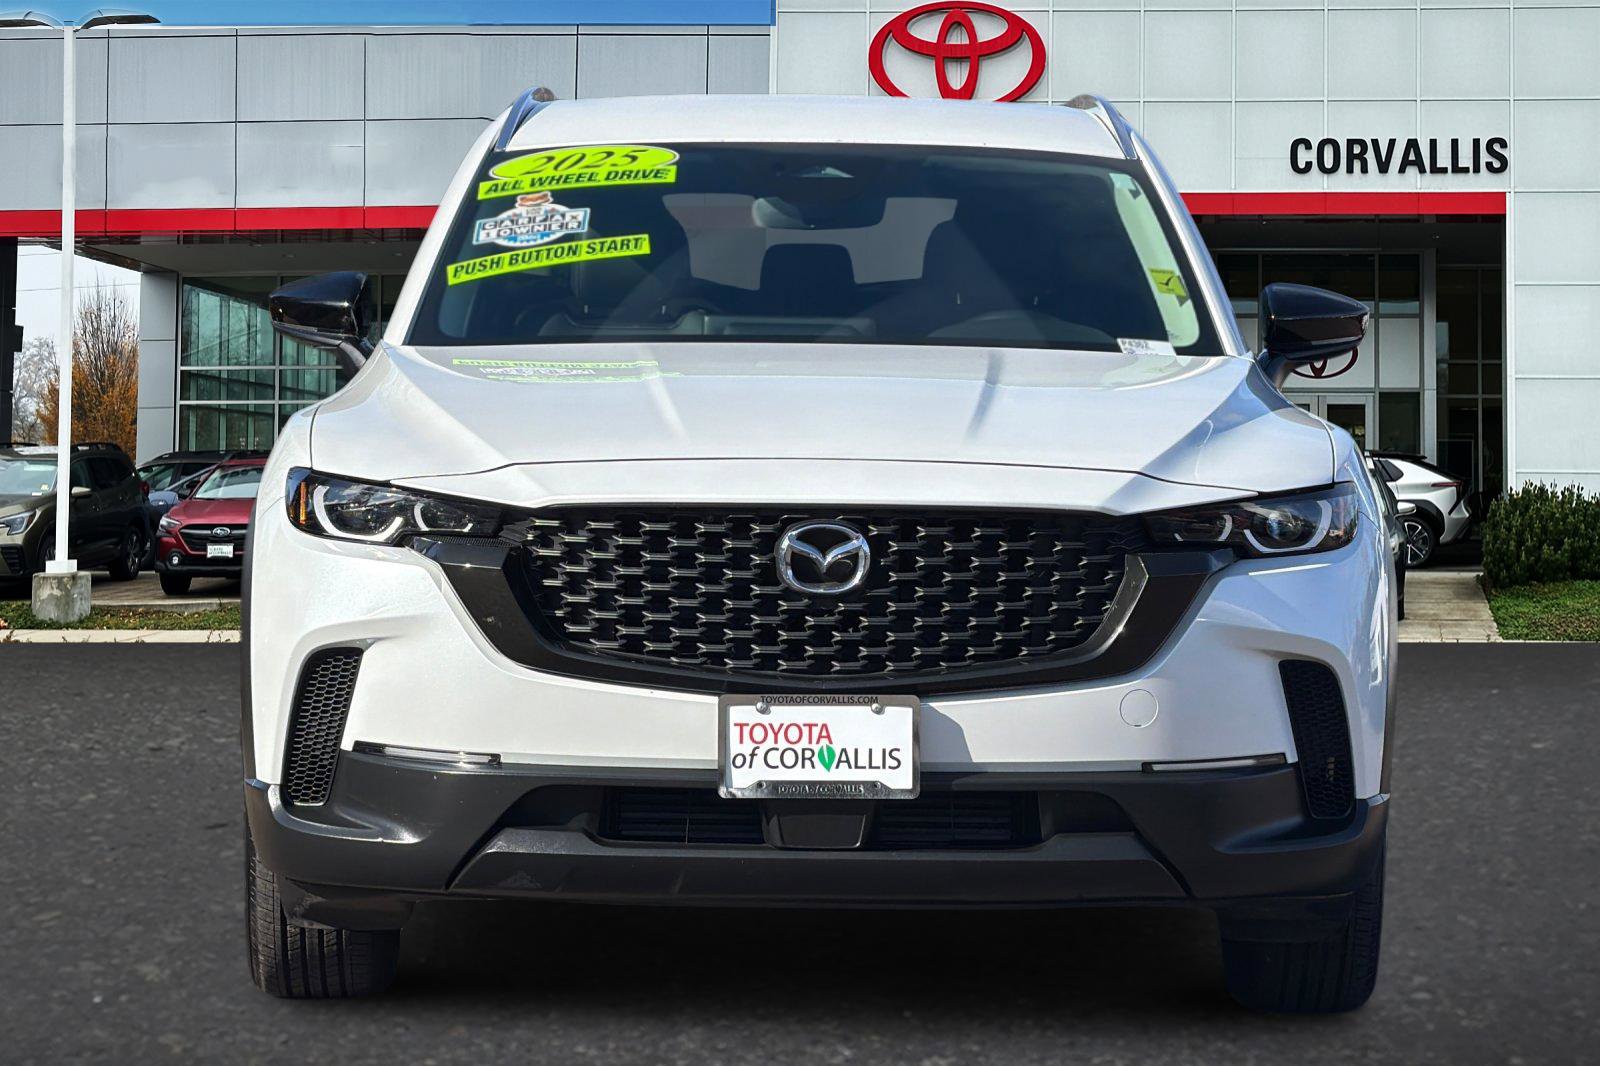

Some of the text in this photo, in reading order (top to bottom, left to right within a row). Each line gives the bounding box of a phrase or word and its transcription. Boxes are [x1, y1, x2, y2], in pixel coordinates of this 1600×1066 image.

[523, 150, 649, 174] 2025
[1290, 137, 1509, 175] CORVALLIS
[485, 167, 669, 195] ALL WHEEL DRIVE
[483, 213, 580, 230] CARFAX
[499, 221, 580, 237] OWNER
[453, 236, 643, 279] PUSH BUTTON START
[760, 695, 879, 704] TOYOTAOFCORVALLIS.COM
[733, 722, 834, 745] TOYOTA
[731, 746, 760, 769] of
